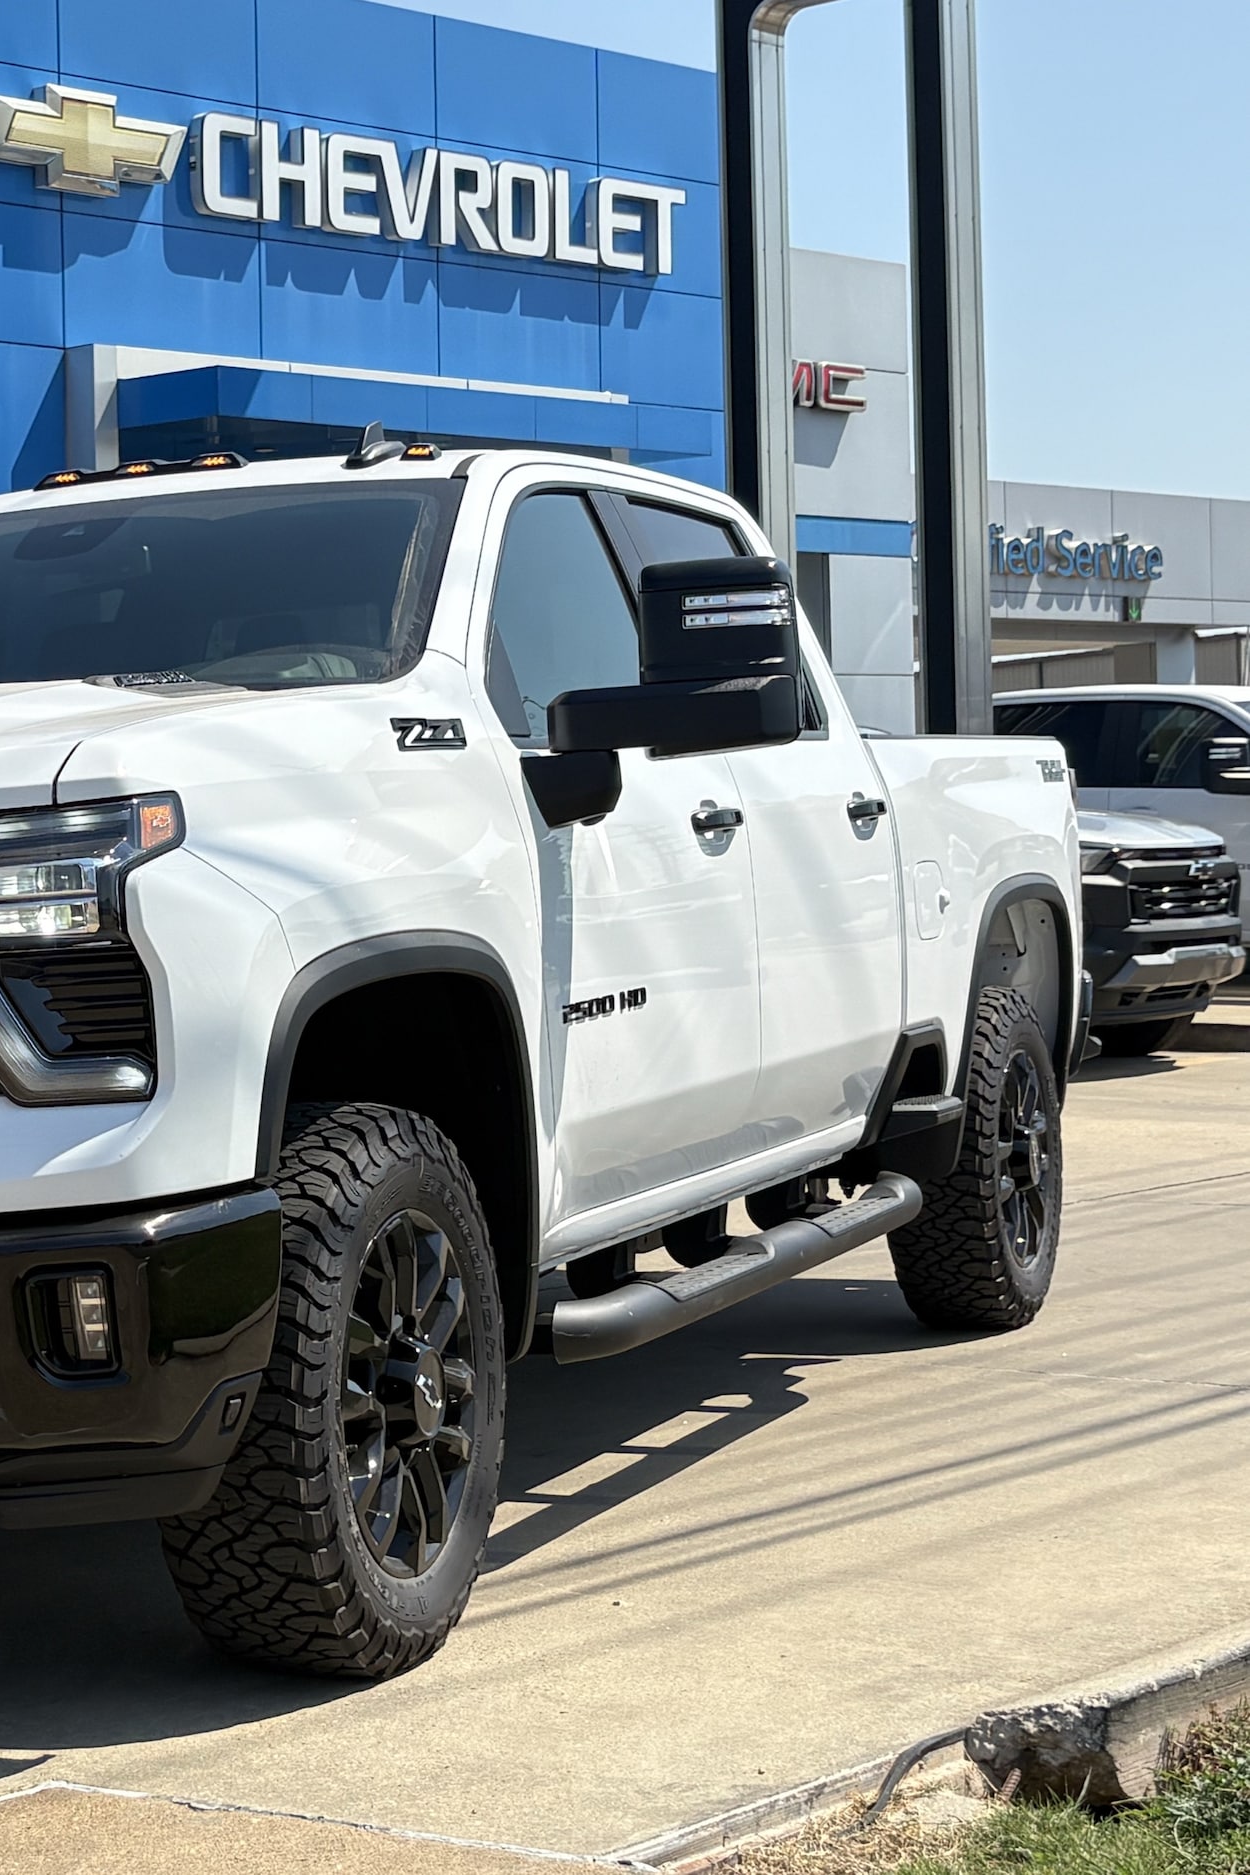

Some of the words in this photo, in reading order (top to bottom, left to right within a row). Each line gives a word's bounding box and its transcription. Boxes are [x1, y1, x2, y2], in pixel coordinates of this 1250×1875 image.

[191, 111, 686, 275] CHEVROLET
[1055, 529, 1163, 581] Service
[390, 718, 467, 752] Z71
[561, 994, 615, 1025] 2500
[619, 986, 647, 1012] HD
